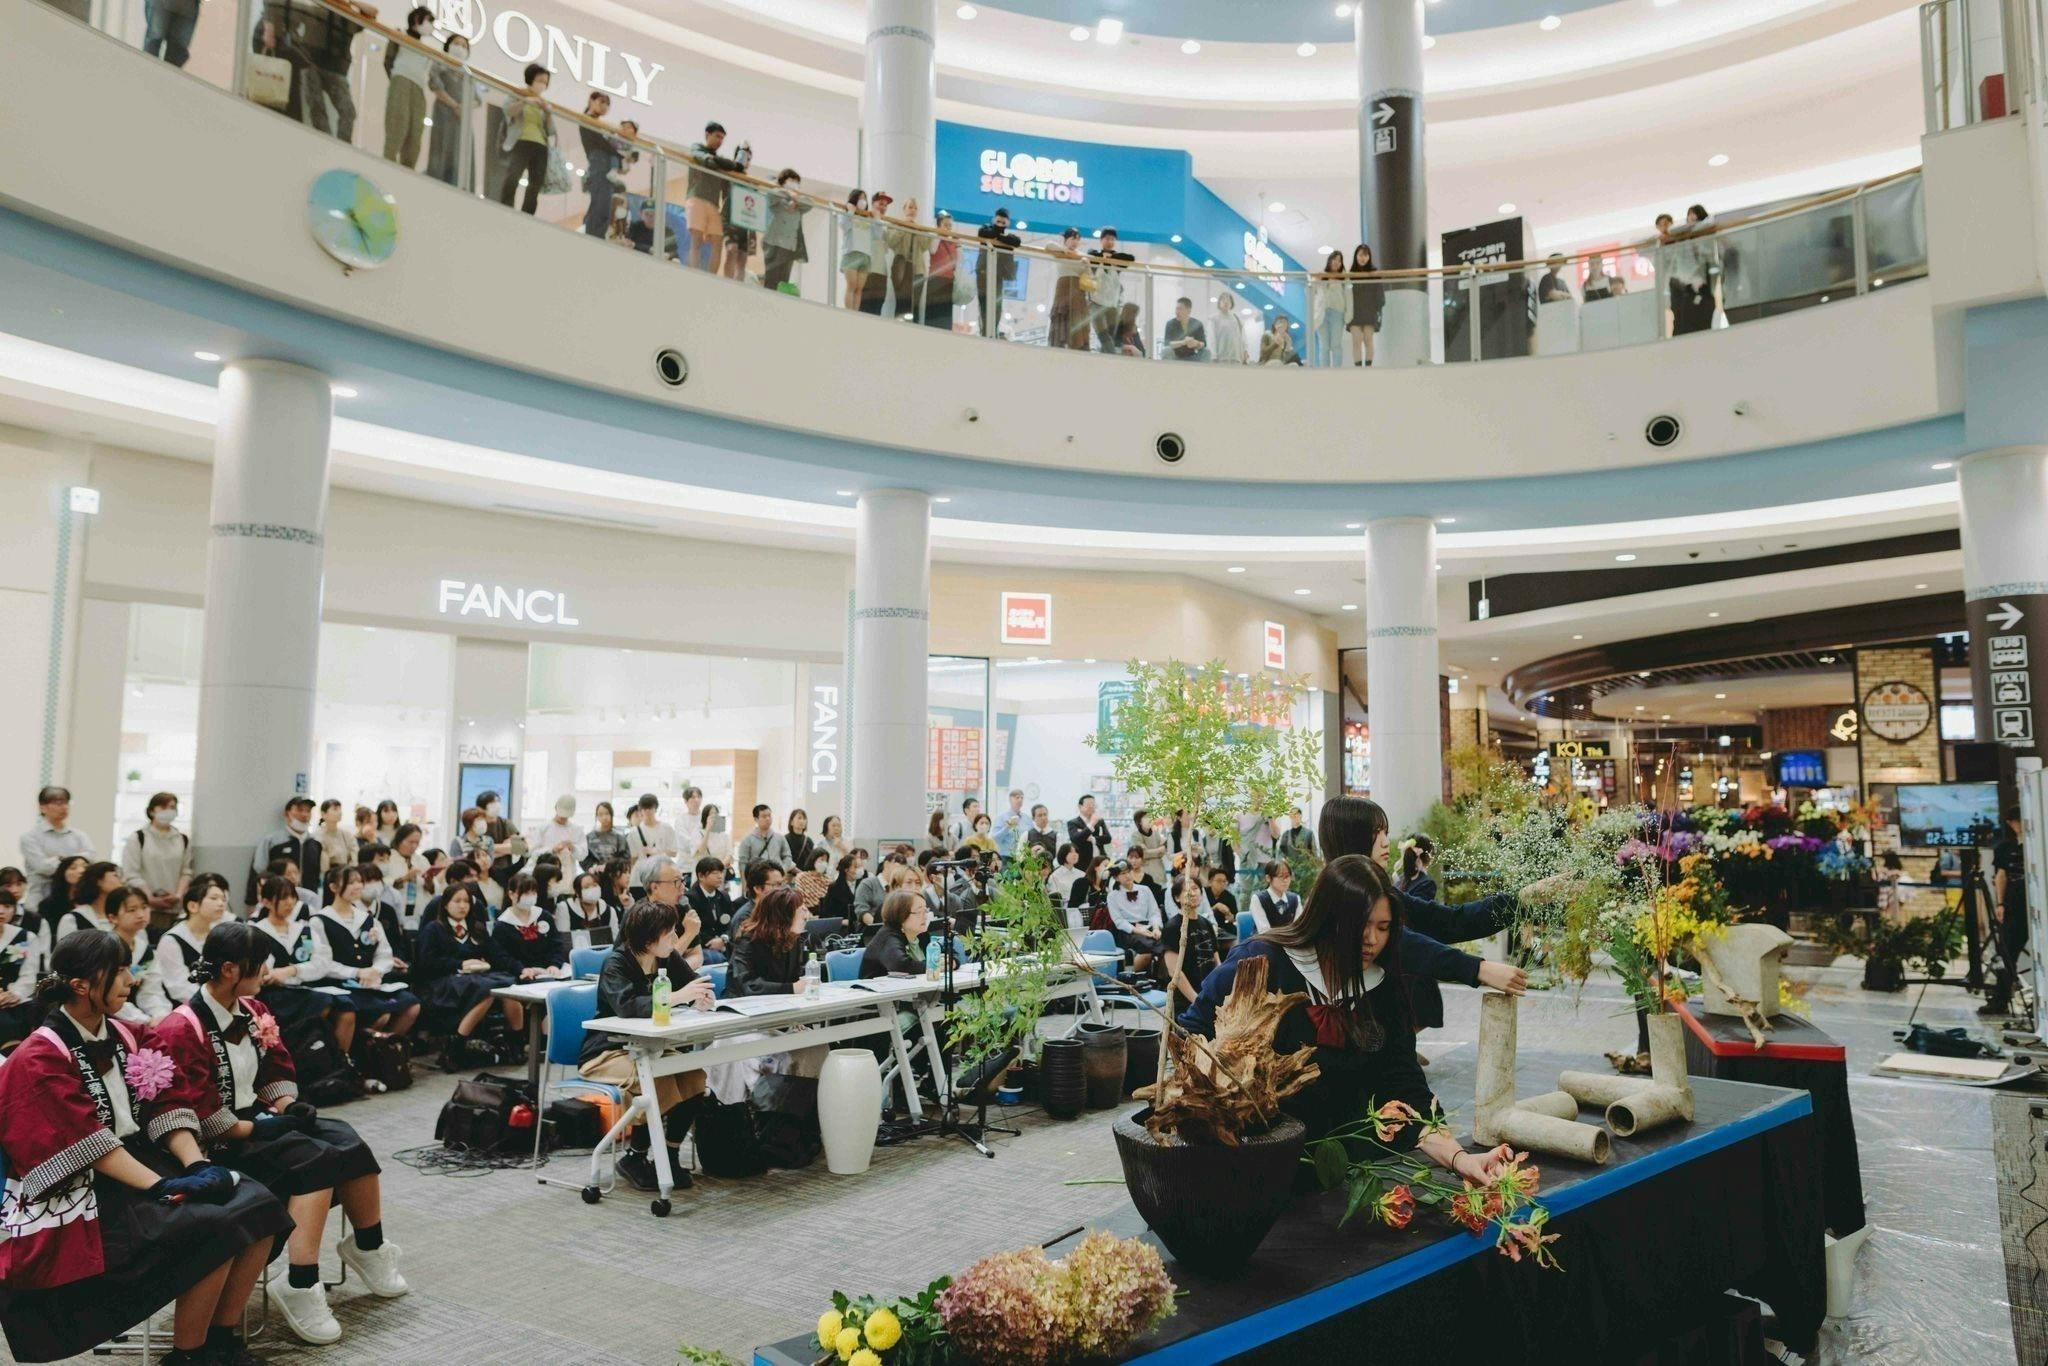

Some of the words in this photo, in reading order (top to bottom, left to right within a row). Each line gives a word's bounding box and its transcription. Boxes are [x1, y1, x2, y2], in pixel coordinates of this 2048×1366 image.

[493, 10, 665, 106] ONLY
[980, 149, 1084, 187] GLOBAL
[980, 174, 1084, 205] SELECTION
[439, 579, 579, 626] FANCL
[1993, 672, 2026, 684] TAXI
[457, 744, 519, 761] FANCL
[812, 686, 838, 794] FANCL
[1556, 741, 1583, 758] KOI
[70, 1045, 112, 1128] 広島工業大学
[207, 1029, 233, 1109] 広島工業大学
